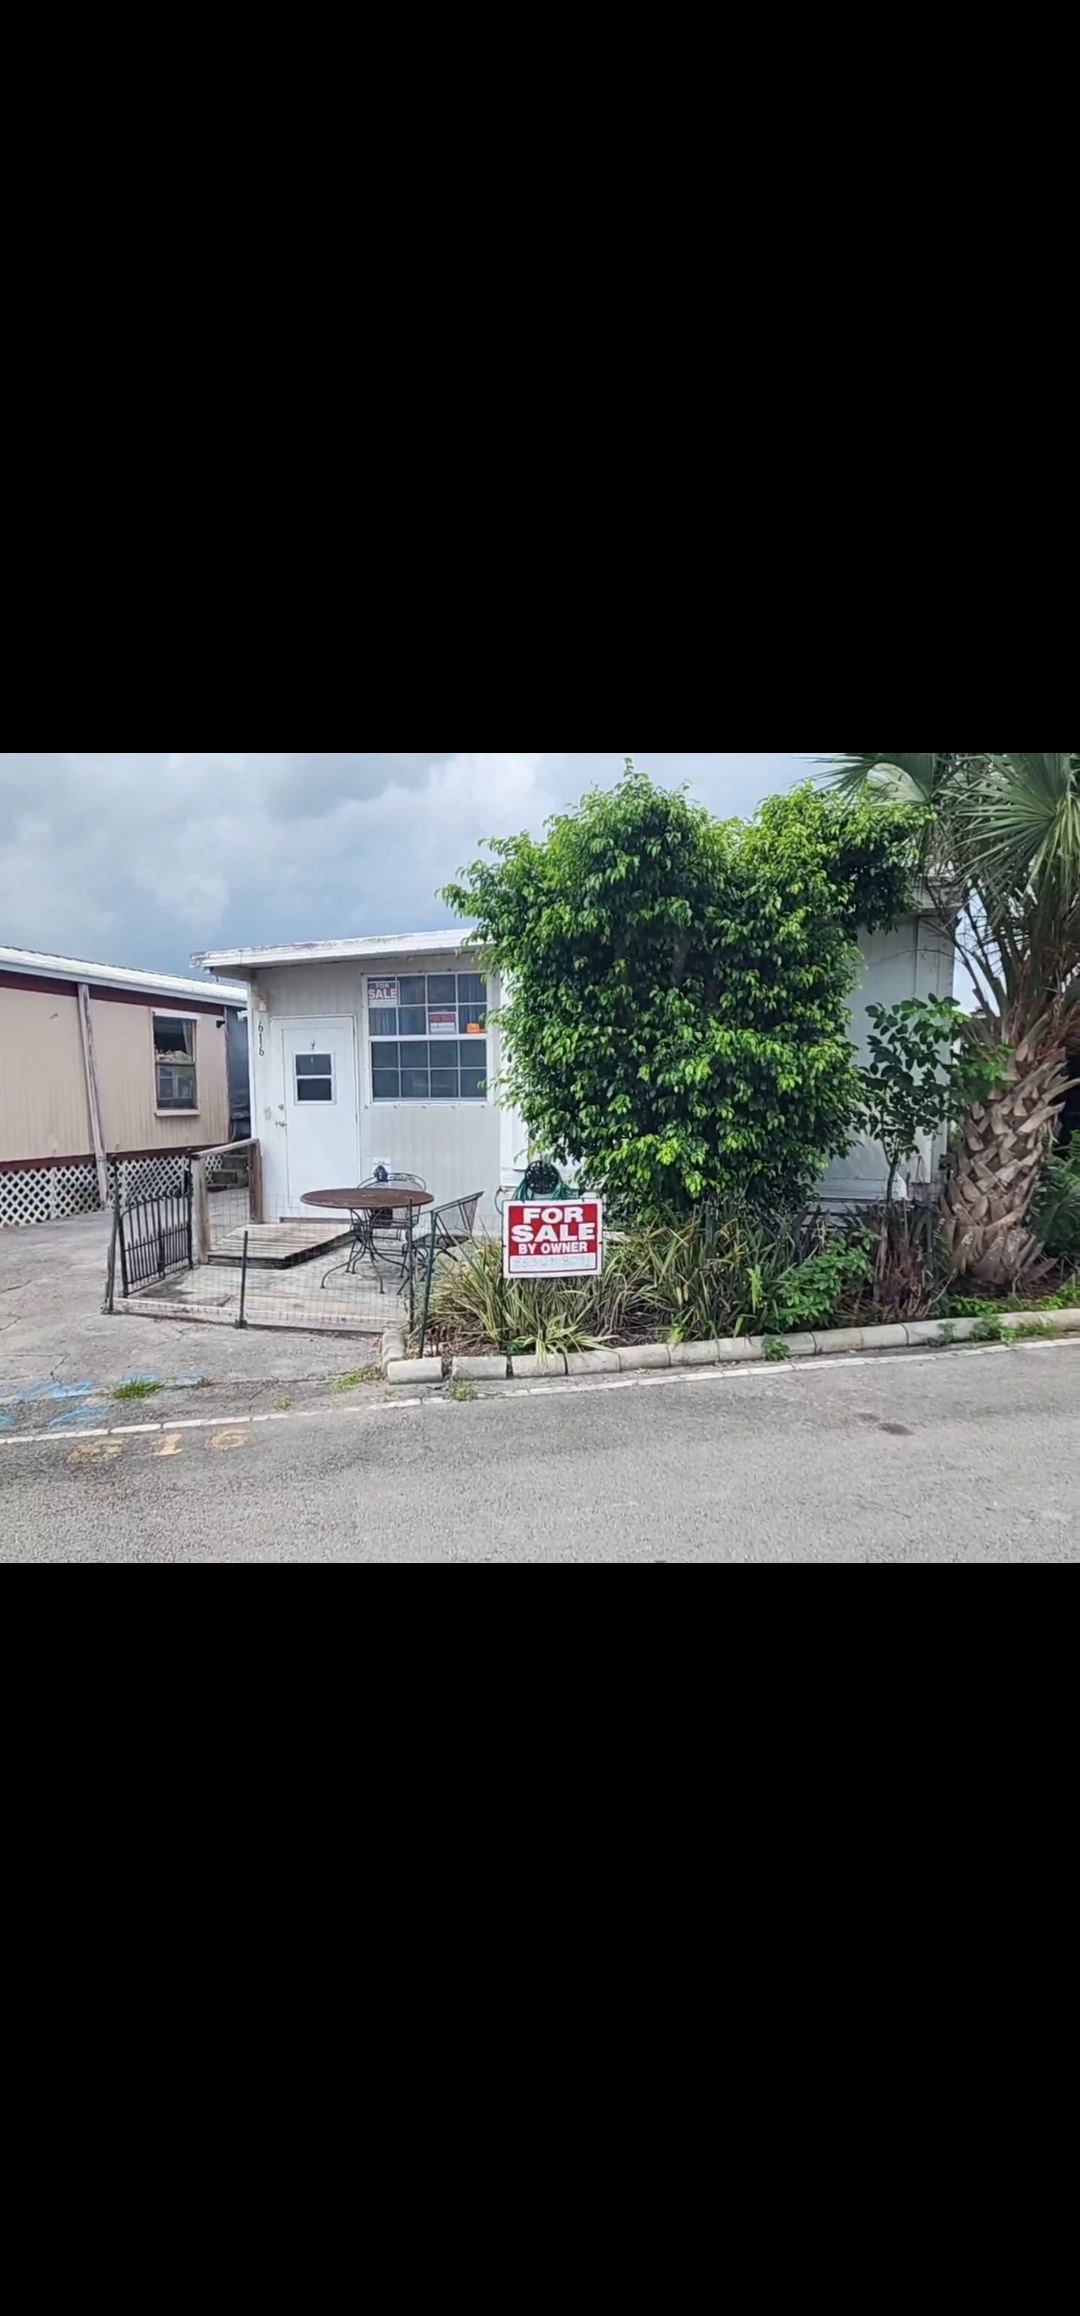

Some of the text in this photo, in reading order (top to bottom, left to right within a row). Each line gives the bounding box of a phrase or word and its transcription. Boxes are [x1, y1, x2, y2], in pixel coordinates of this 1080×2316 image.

[368, 988, 397, 999] SALE
[523, 1206, 583, 1224] FOR
[511, 1222, 595, 1243] SALE
[518, 1241, 588, 1254] BY OWNER
